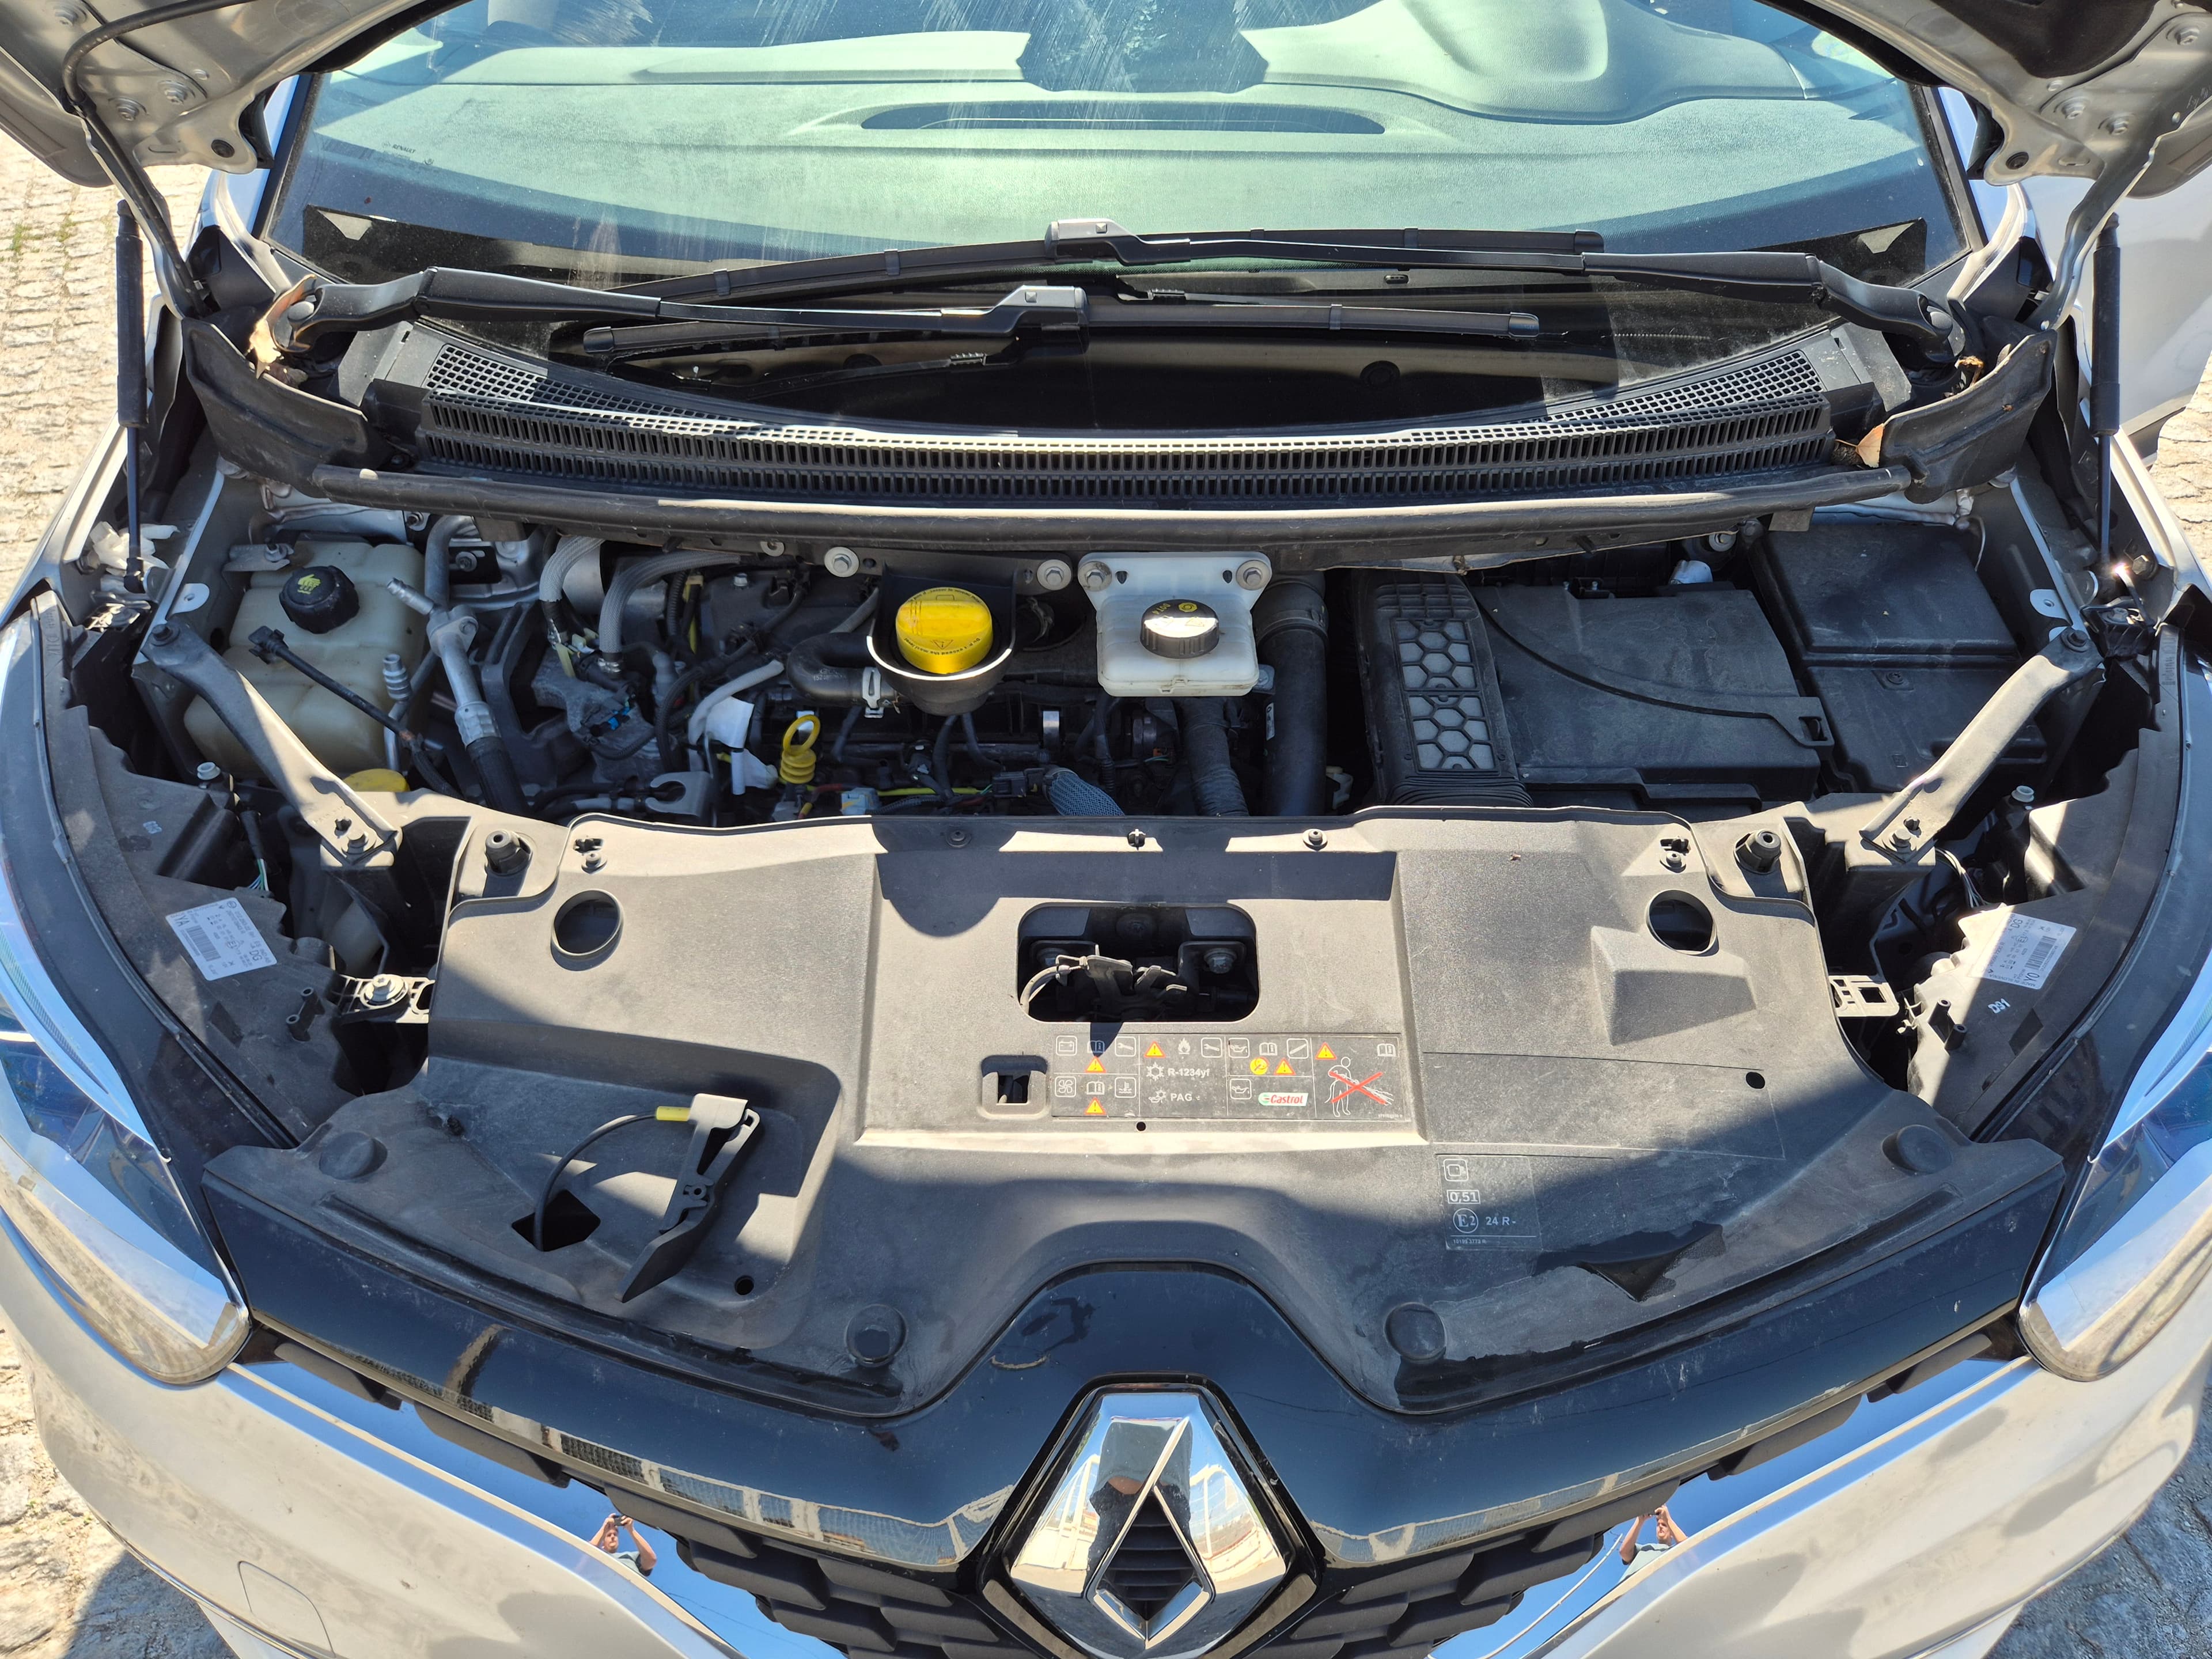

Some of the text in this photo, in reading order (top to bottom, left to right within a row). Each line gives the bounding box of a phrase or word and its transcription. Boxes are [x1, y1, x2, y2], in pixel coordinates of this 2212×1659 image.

[1168, 1067, 1210, 1078] R-1234yf
[1170, 1093, 1192, 1101] PAG
[1270, 1094, 1303, 1104] Castrol
[1486, 1216, 1499, 1226] 24
